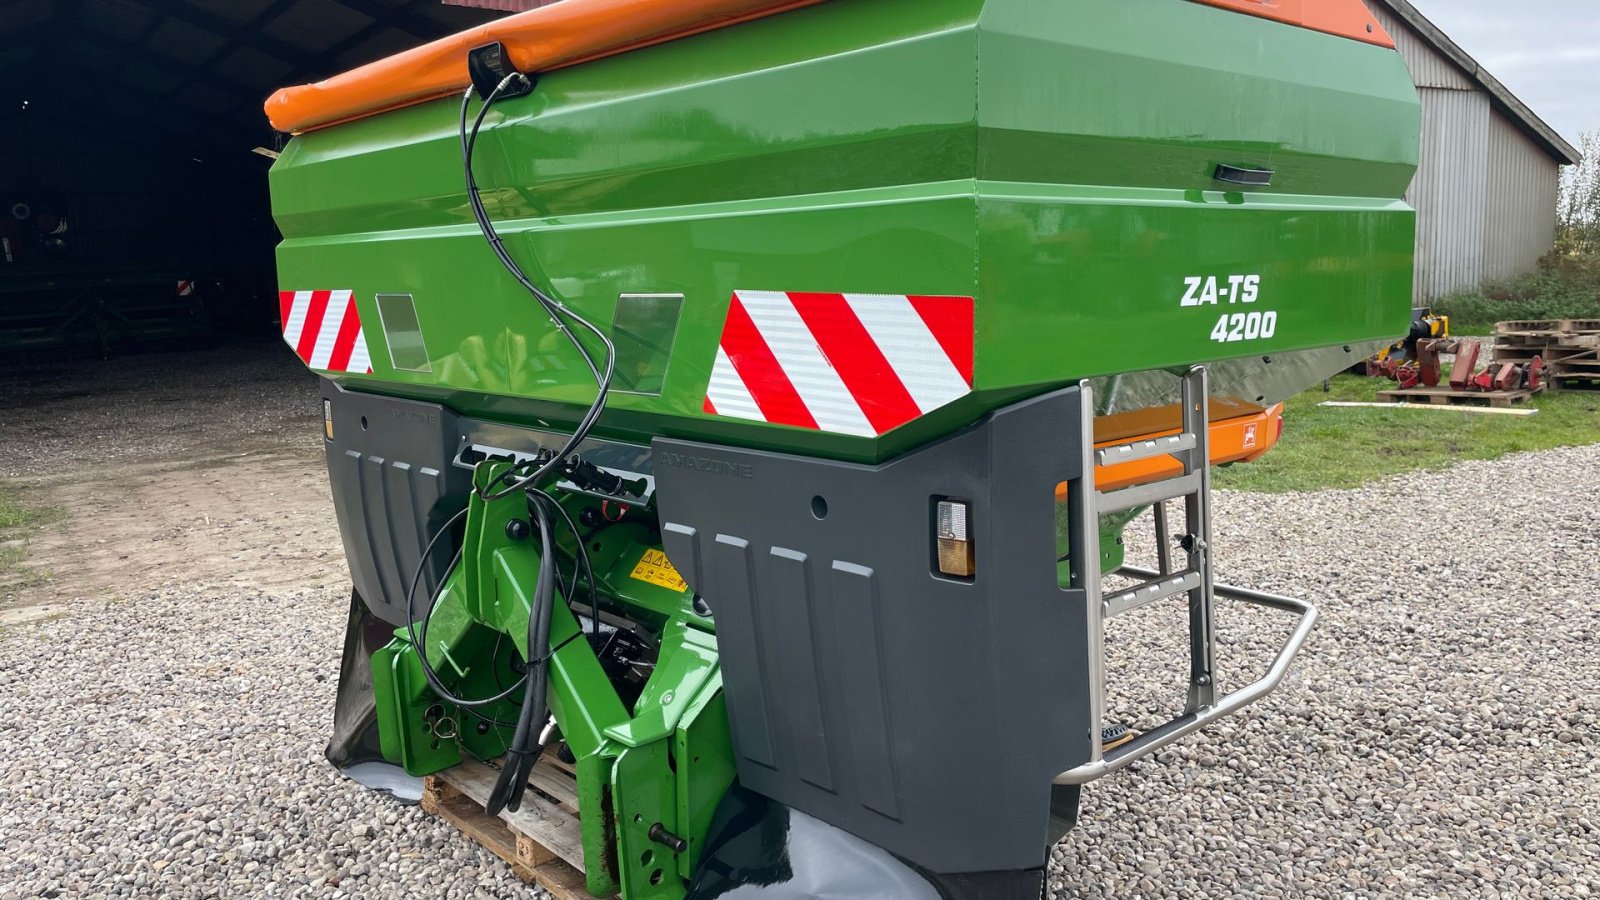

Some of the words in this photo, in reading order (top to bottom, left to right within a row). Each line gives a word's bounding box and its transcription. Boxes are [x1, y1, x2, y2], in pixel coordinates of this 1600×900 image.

[1180, 274, 1260, 306] ZA-TS
[1210, 311, 1277, 342] 4200
[661, 452, 753, 480] AMAZONE
